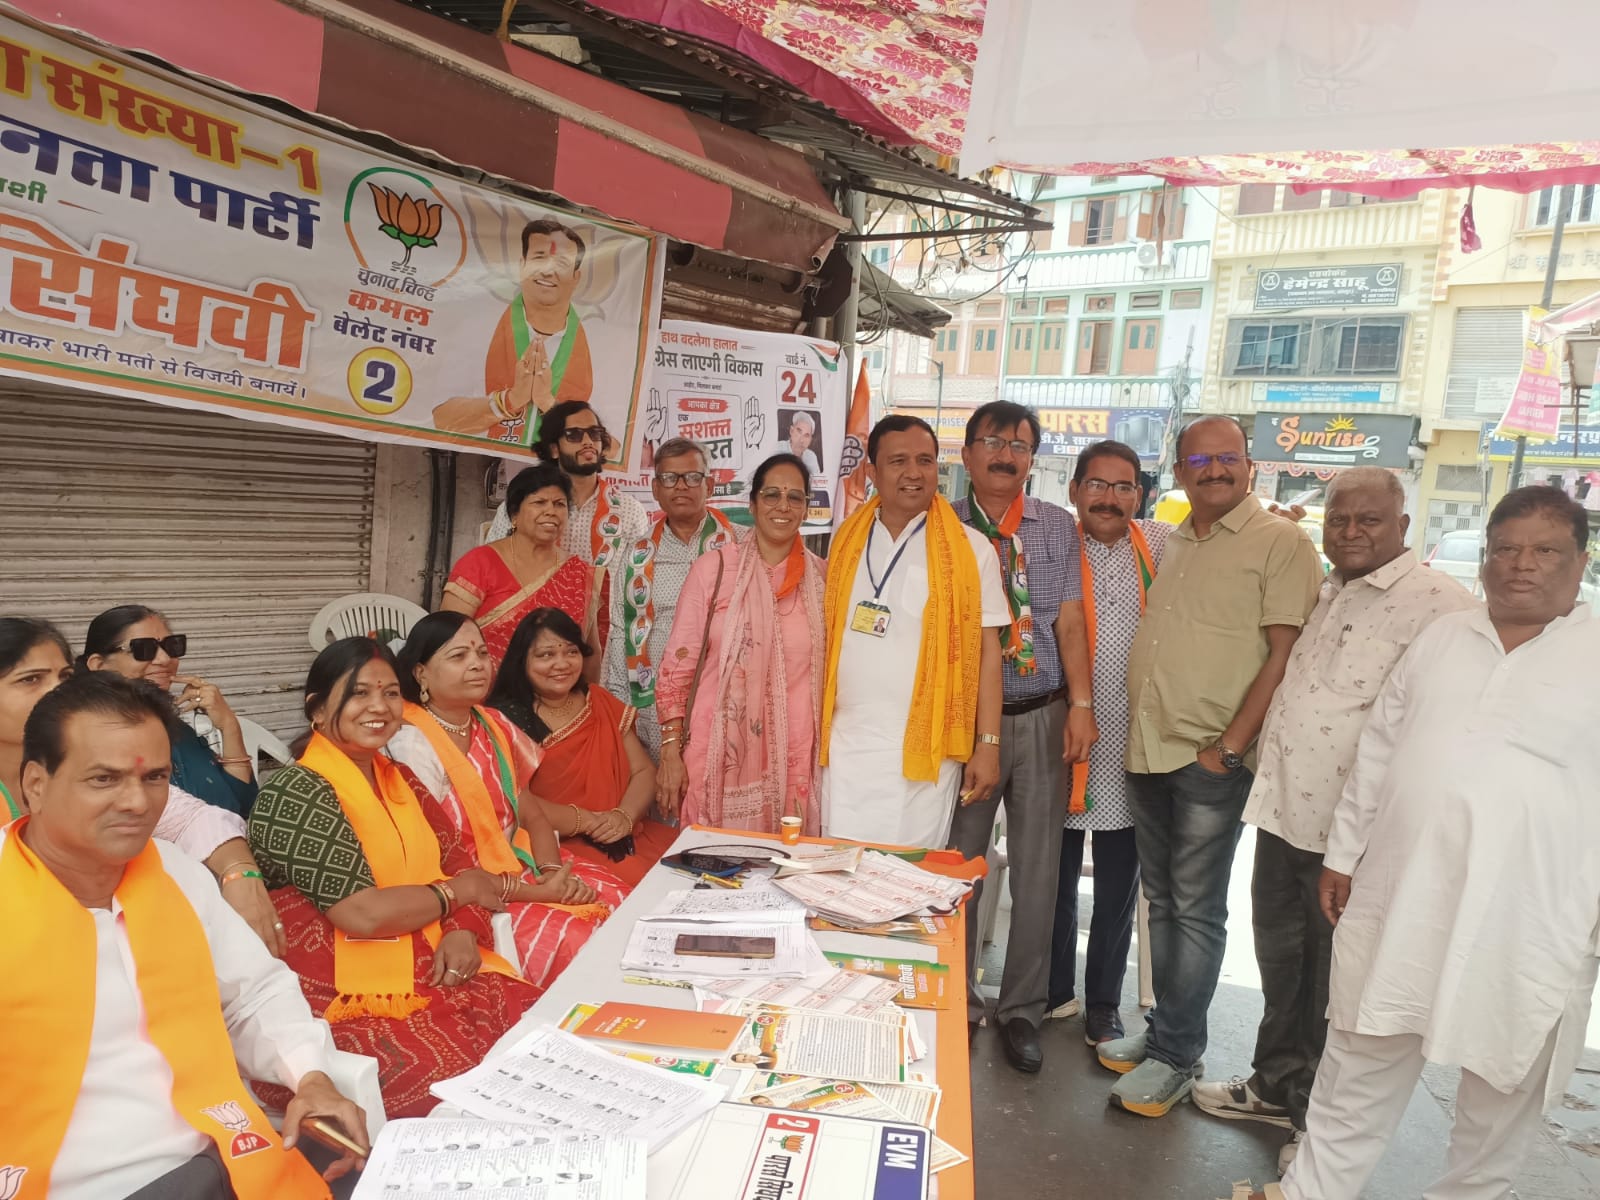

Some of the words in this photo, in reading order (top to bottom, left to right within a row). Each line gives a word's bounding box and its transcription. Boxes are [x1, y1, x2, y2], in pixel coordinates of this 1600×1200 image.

[0, 115, 158, 203] नता
[169, 169, 321, 250] पार्टी
[357, 268, 400, 290] चुनाव
[400, 277, 438, 301] चिन्ह
[348, 289, 434, 327] कमल
[333, 311, 387, 343] बेलेट
[391, 327, 437, 355] नंबर
[661, 331, 678, 344] हाथ
[713, 338, 738, 351] हालात
[62, 342, 112, 363] भारी
[160, 356, 178, 374] से
[184, 361, 244, 388] विजयी
[655, 345, 678, 368] ग्रेस
[681, 352, 721, 373] लाएगी
[724, 354, 763, 376] विकास
[785, 352, 799, 366] वार्ड
[363, 360, 396, 403] 2
[781, 370, 816, 404] 24
[1037, 408, 1110, 434] पारस
[1276, 415, 1366, 453] Sunrise
[707, 438, 733, 459] रत
[777, 1118, 810, 1129] 2
[237, 1136, 259, 1151] BJP
[884, 1133, 918, 1169] EVM
[765, 1154, 792, 1180] पारस
[752, 1179, 794, 1200] सिंघ
